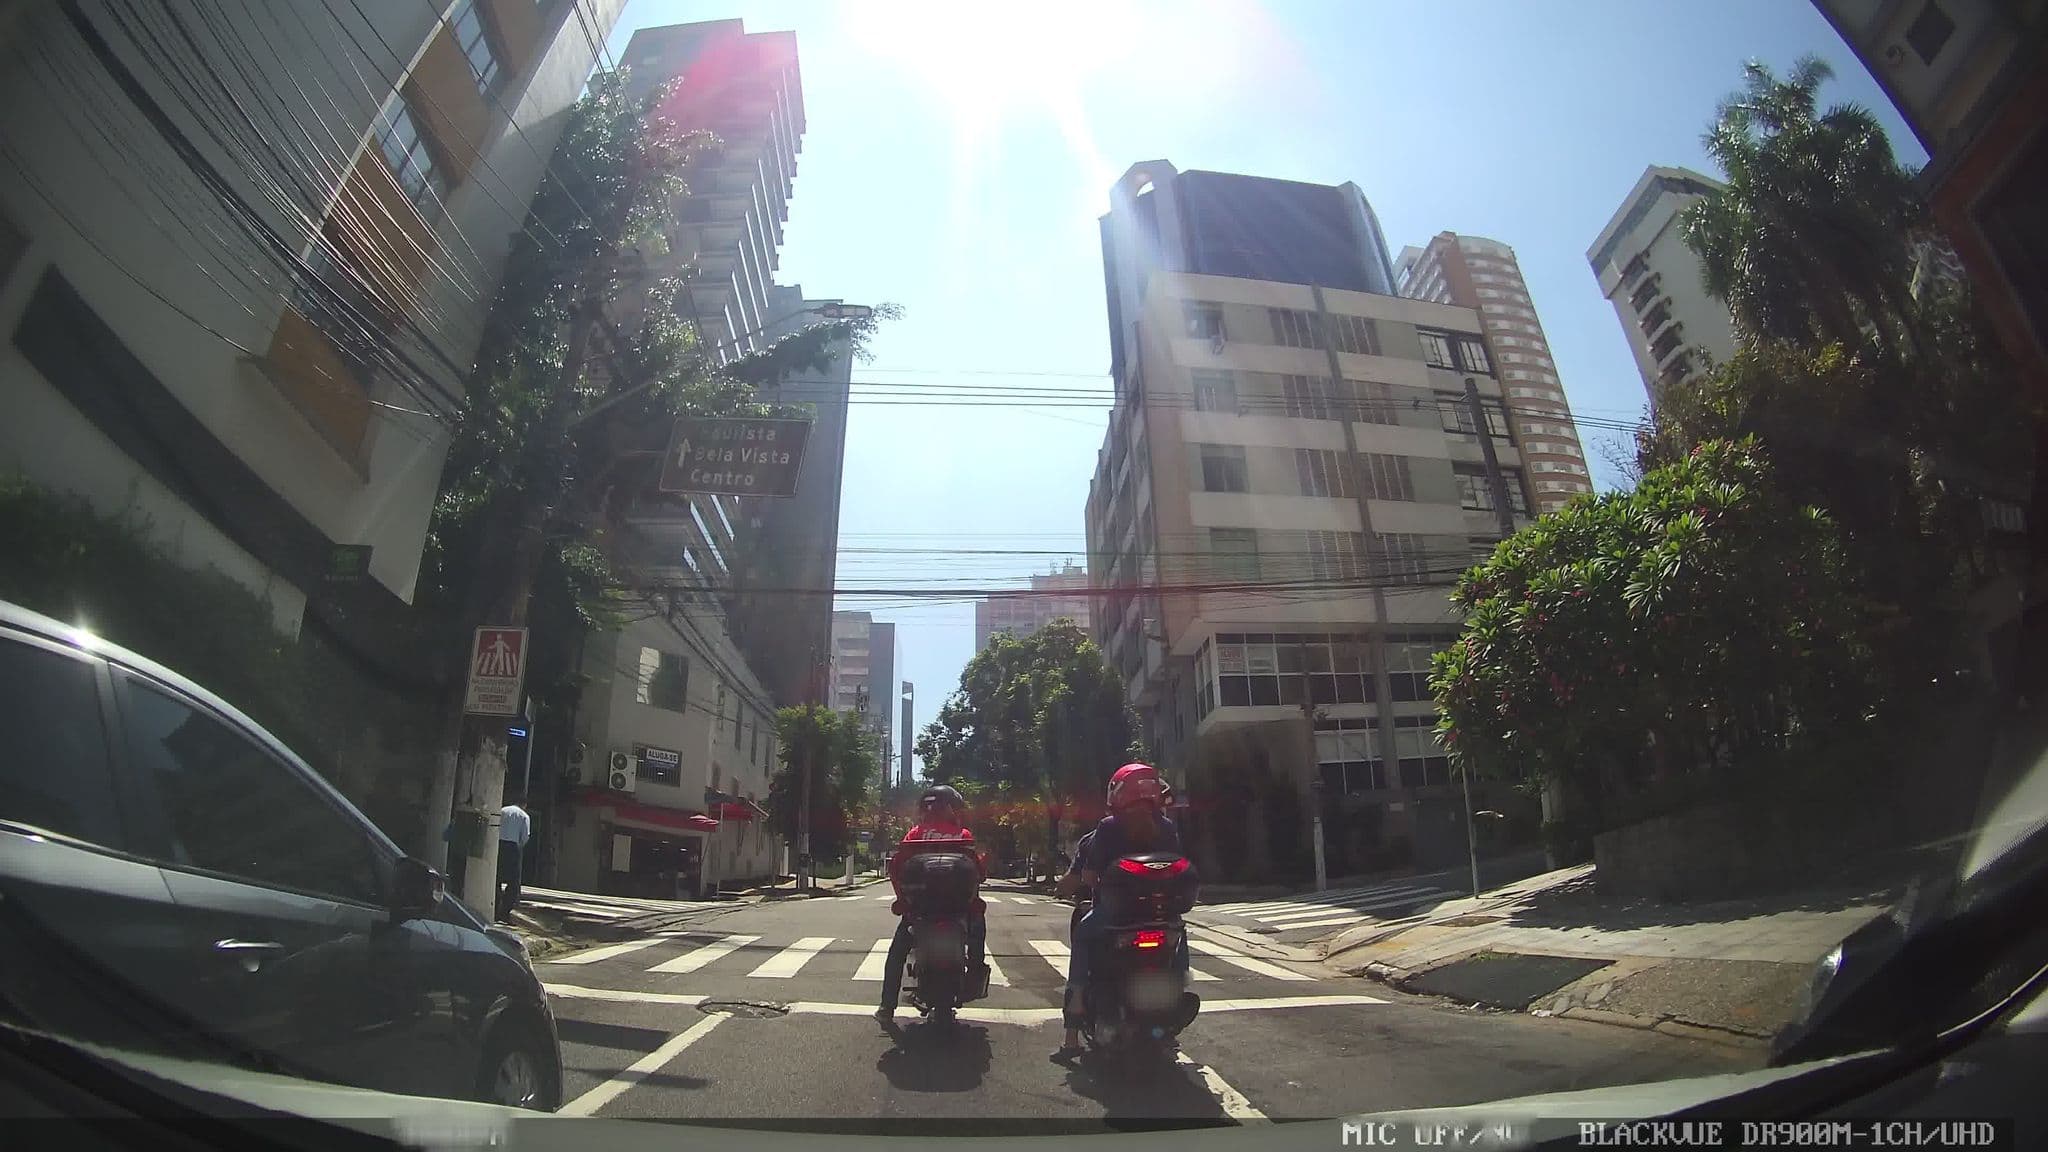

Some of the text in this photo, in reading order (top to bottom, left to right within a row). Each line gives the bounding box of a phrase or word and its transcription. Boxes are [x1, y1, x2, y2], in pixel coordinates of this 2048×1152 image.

[701, 424, 777, 441] aulista
[694, 446, 790, 464] Bela Vista
[690, 469, 755, 486] Centro
